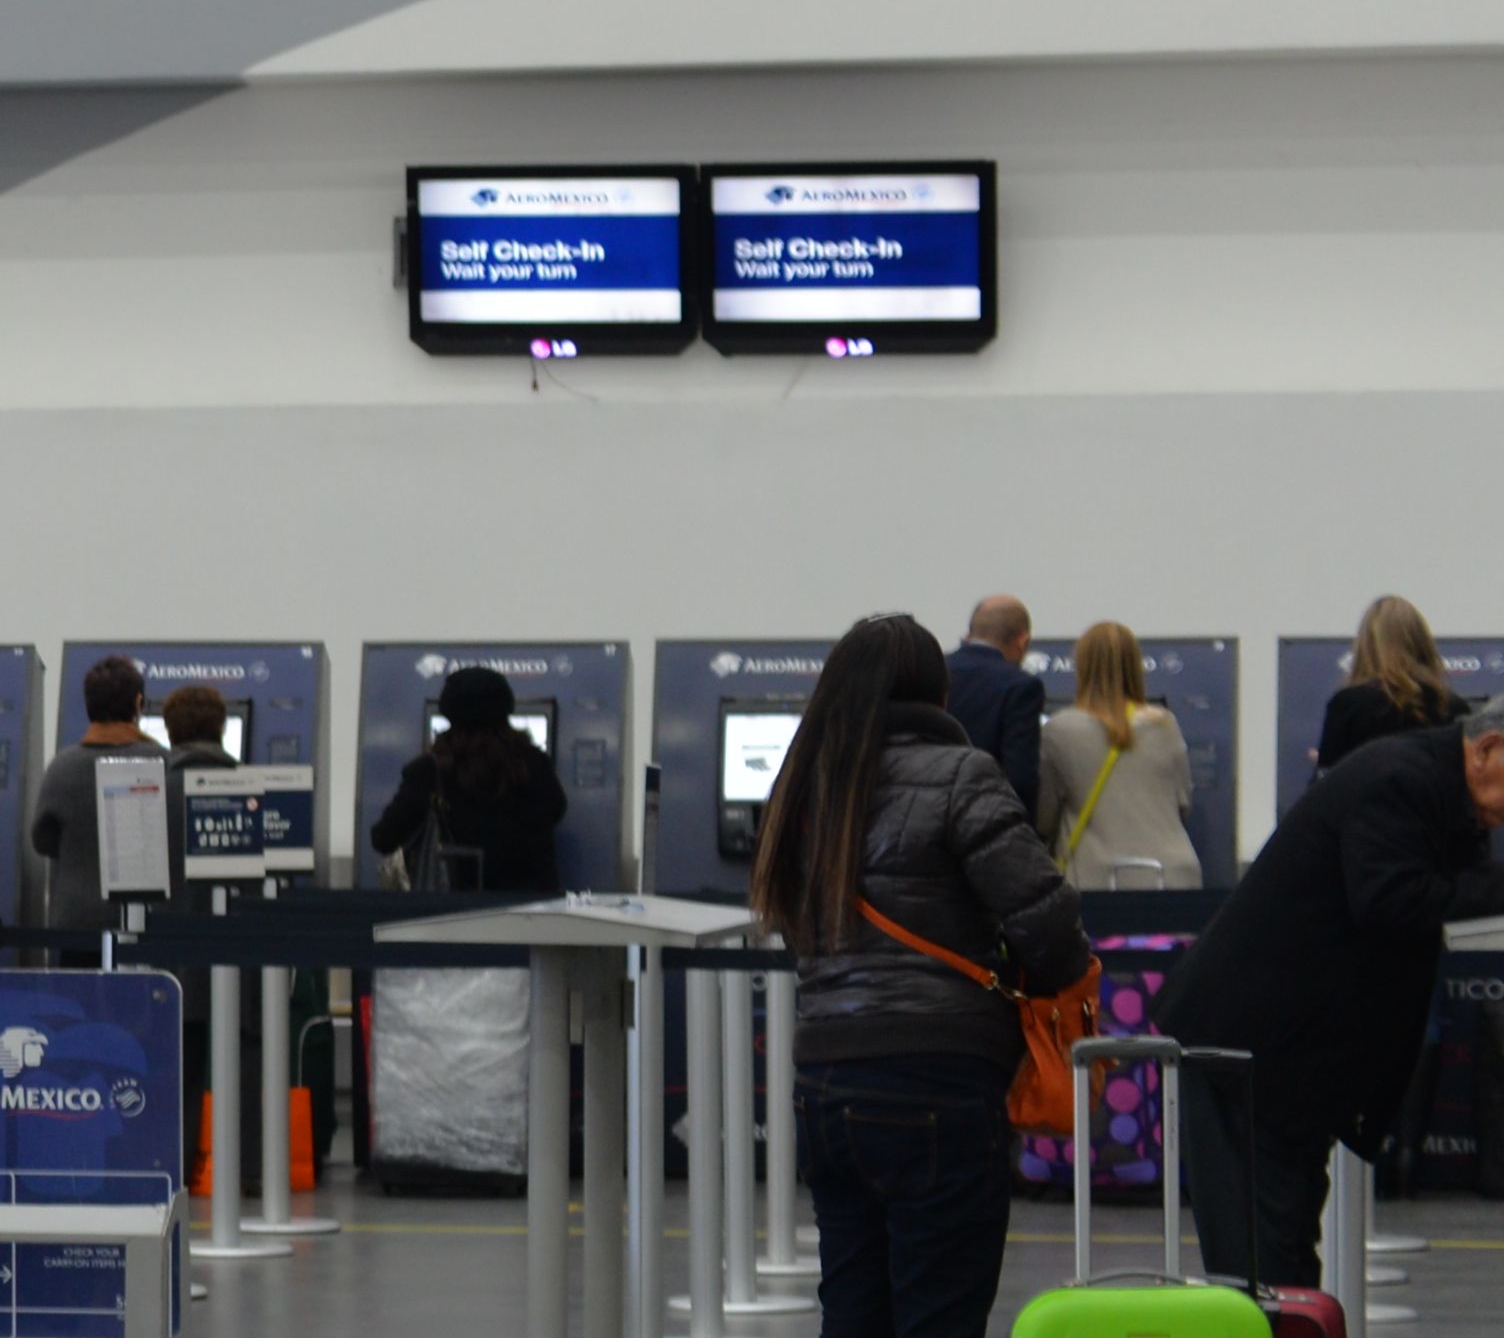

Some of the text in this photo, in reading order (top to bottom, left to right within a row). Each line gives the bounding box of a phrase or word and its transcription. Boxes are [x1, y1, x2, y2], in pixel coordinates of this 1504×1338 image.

[506, 192, 608, 205] AEROMEXICO
[802, 187, 907, 201] AEROMEXICO
[440, 238, 605, 261] Self Check-In
[734, 236, 904, 260] Self Check-In
[441, 262, 577, 283] Wait your turn
[734, 260, 874, 282] Wait your turn
[147, 665, 245, 679] AEROMEXICO
[64, 1248, 120, 1257] CHECK YOUR
